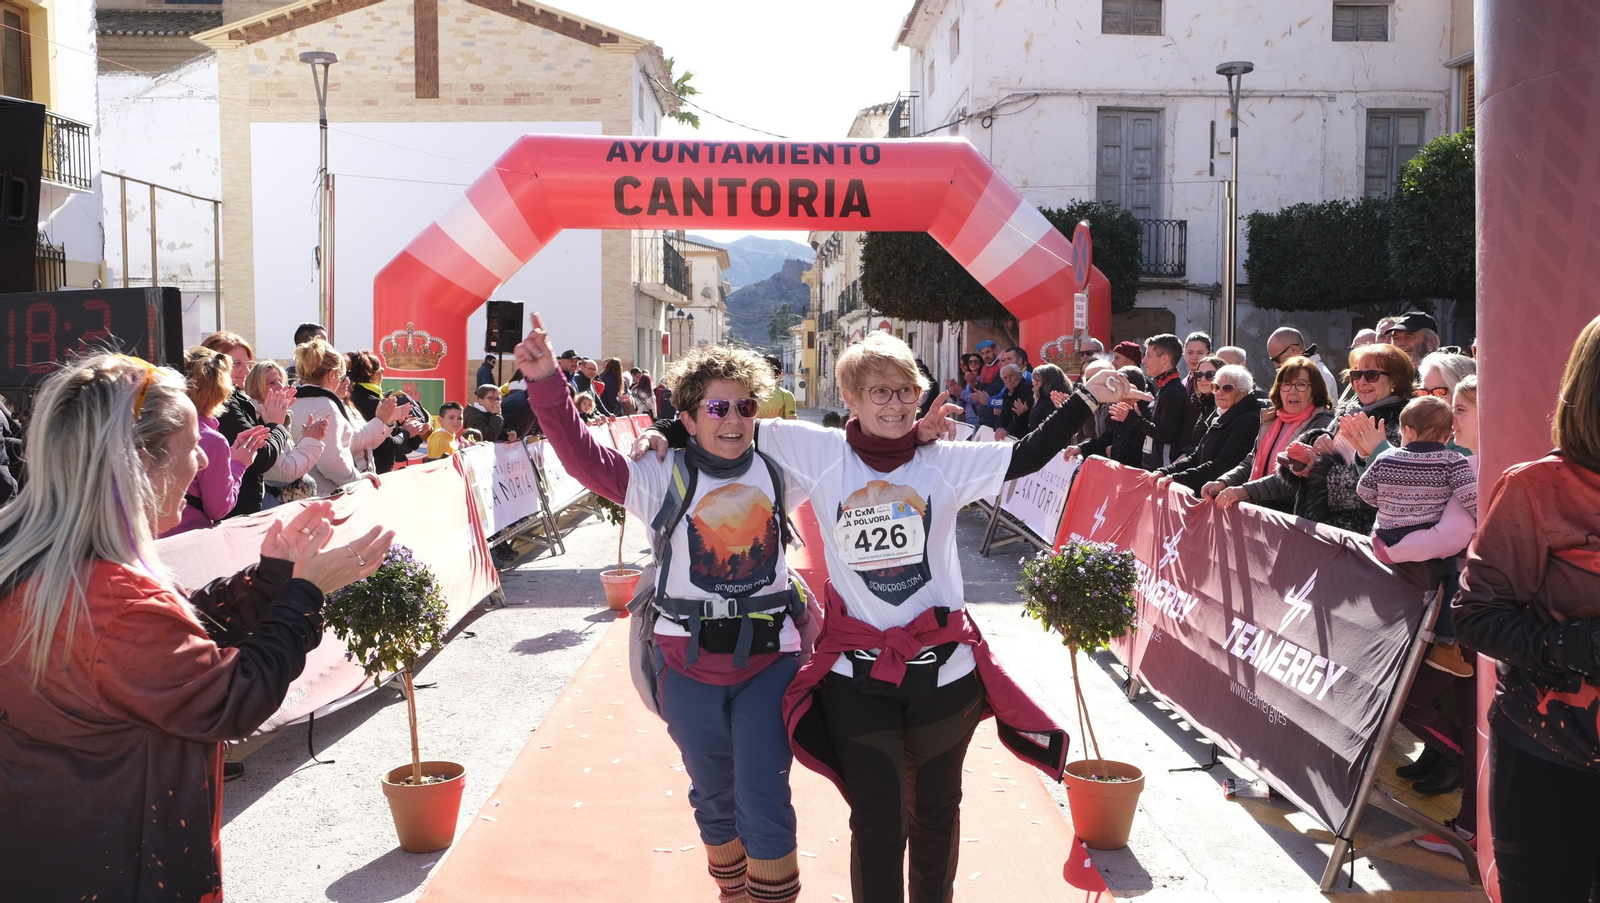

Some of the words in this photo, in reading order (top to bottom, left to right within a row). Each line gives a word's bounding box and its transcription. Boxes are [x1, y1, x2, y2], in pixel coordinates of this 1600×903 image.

[606, 141, 881, 165] AYUNTAMIENTO
[613, 175, 872, 218] CANTORIA
[854, 507, 875, 517] CxM
[854, 514, 891, 527] PÓLVORA
[854, 524, 908, 553] 426
[868, 573, 923, 592] SENDEROS.COM
[1222, 616, 1348, 701] TEAMERGY
